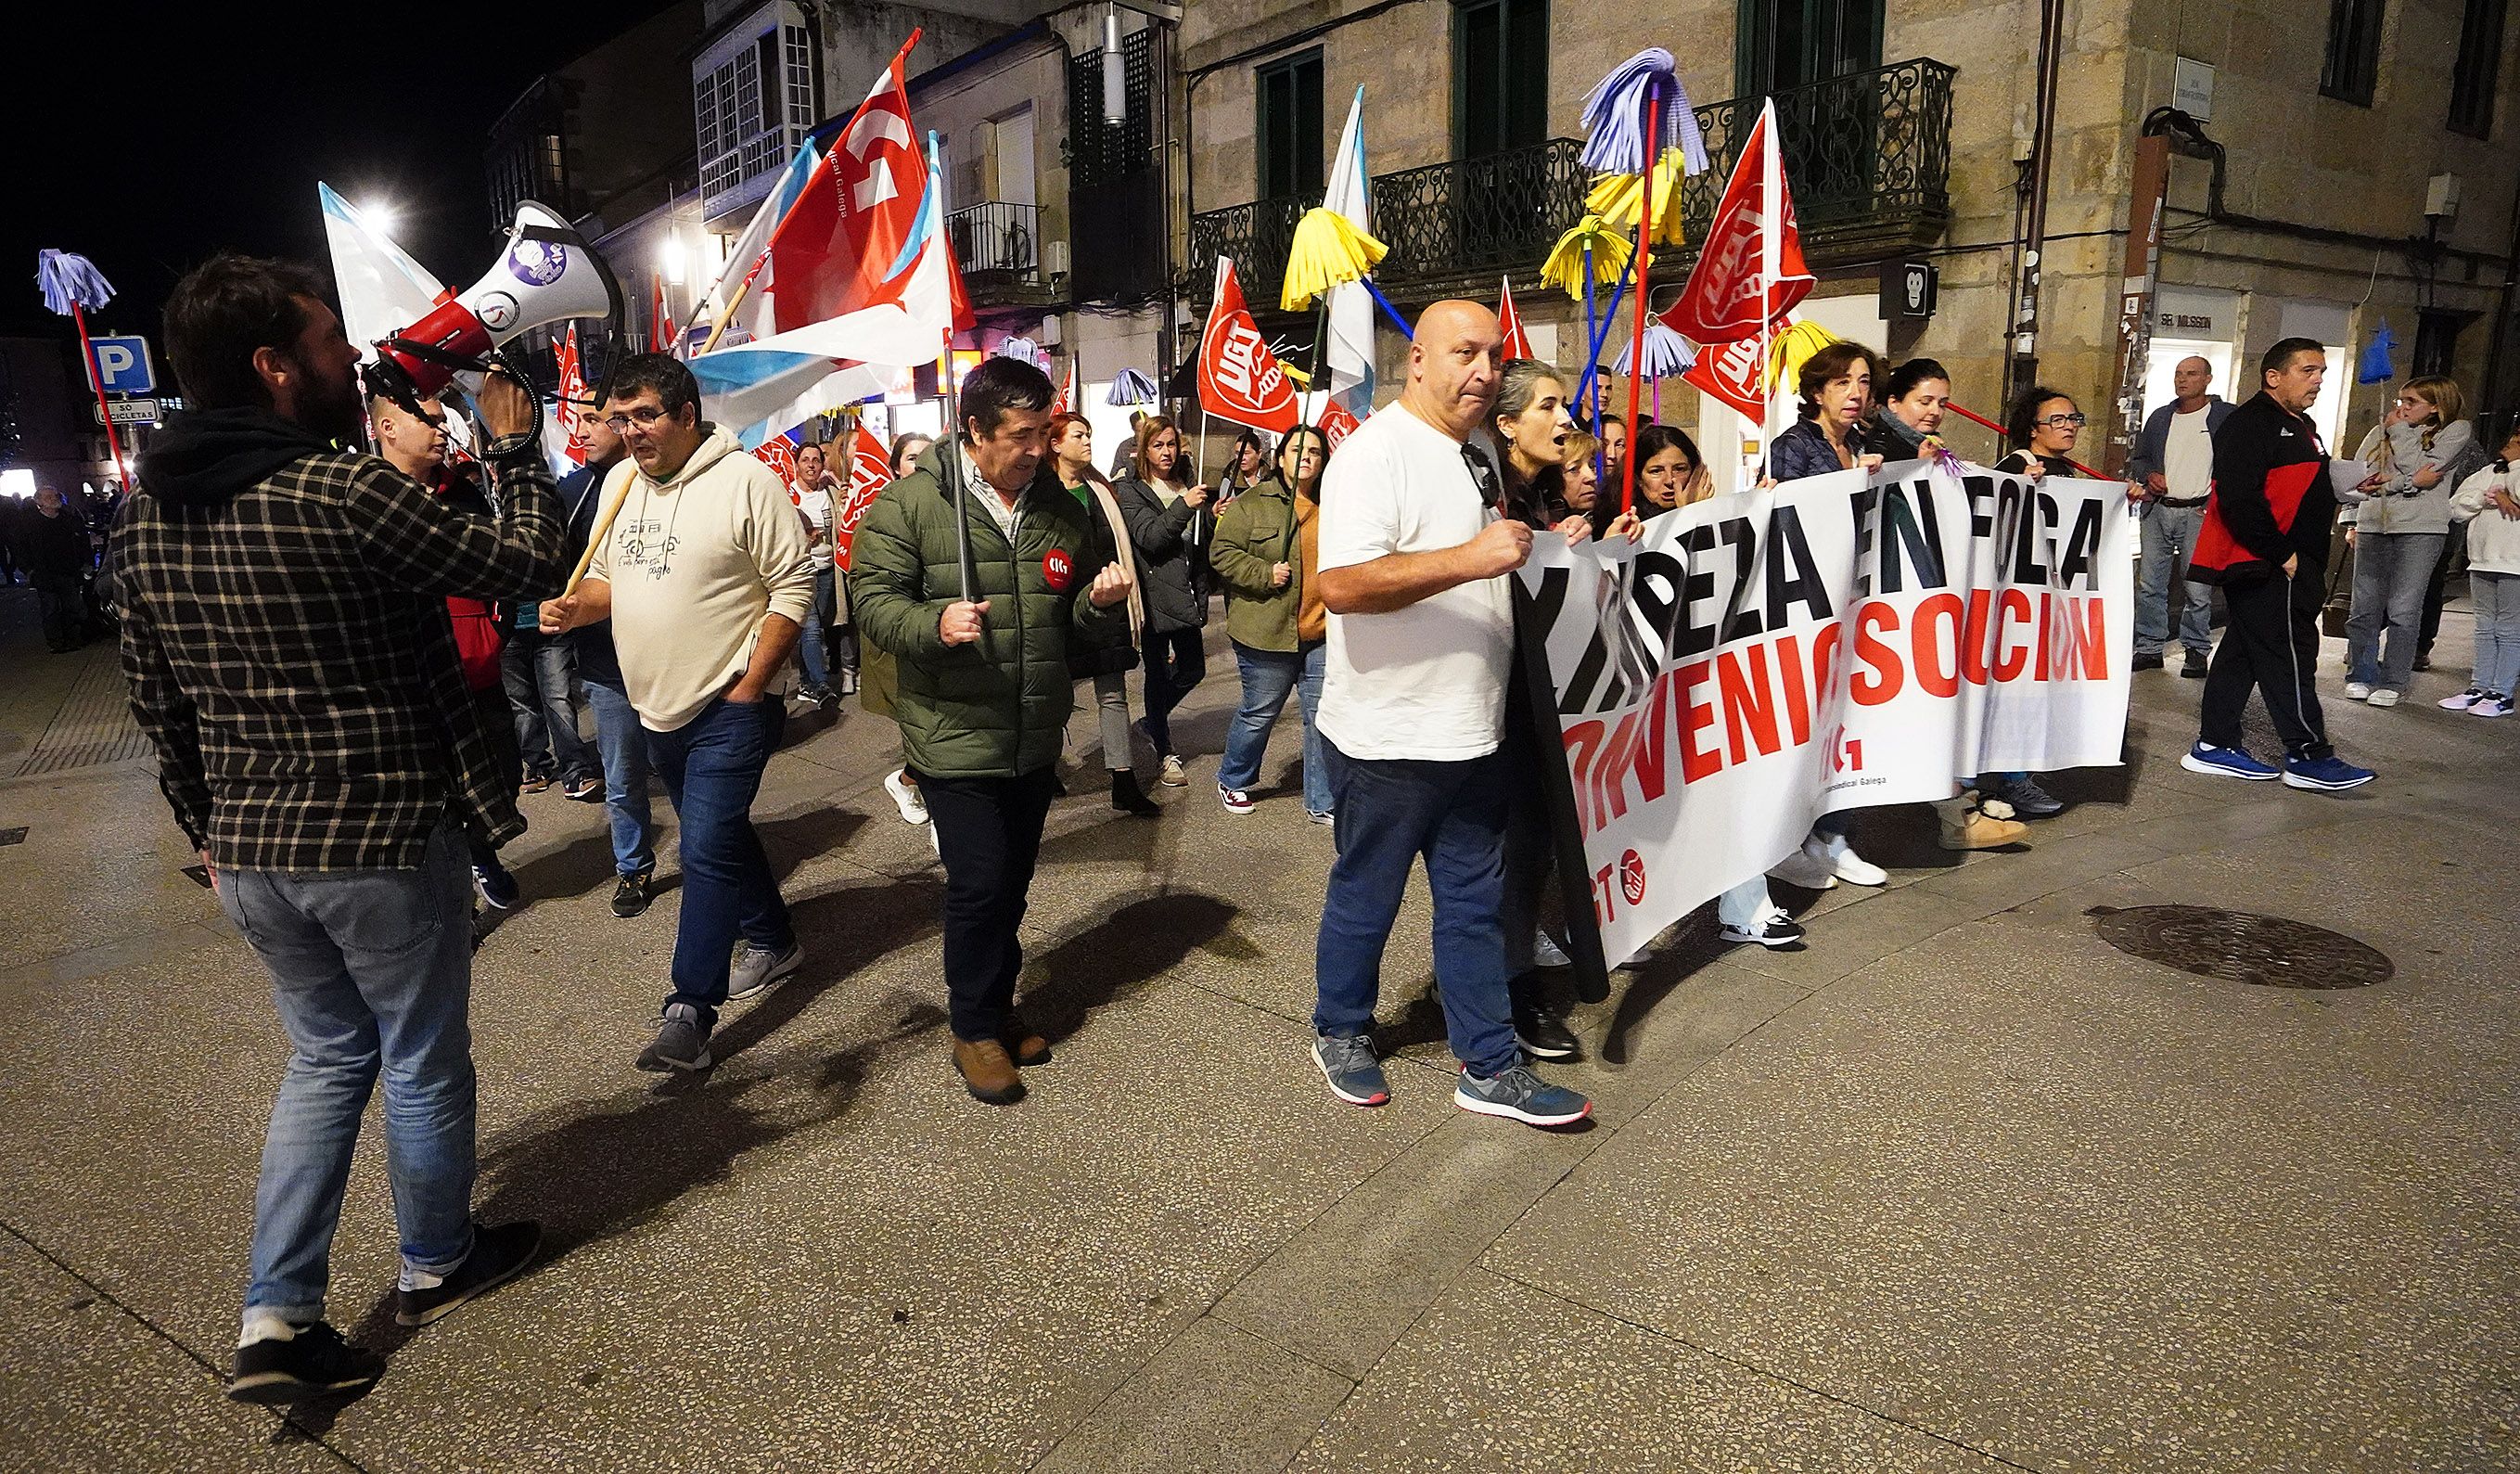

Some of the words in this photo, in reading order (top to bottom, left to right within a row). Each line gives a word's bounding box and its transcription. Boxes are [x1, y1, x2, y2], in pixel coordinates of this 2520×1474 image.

[836, 178, 848, 219] Galega
[97, 345, 134, 385] P
[1216, 317, 1260, 397] UGT
[1716, 337, 1762, 384] UG
[101, 411, 154, 421] BCICLETAS
[1327, 416, 1349, 455] GT
[1849, 478, 1947, 598] EN
